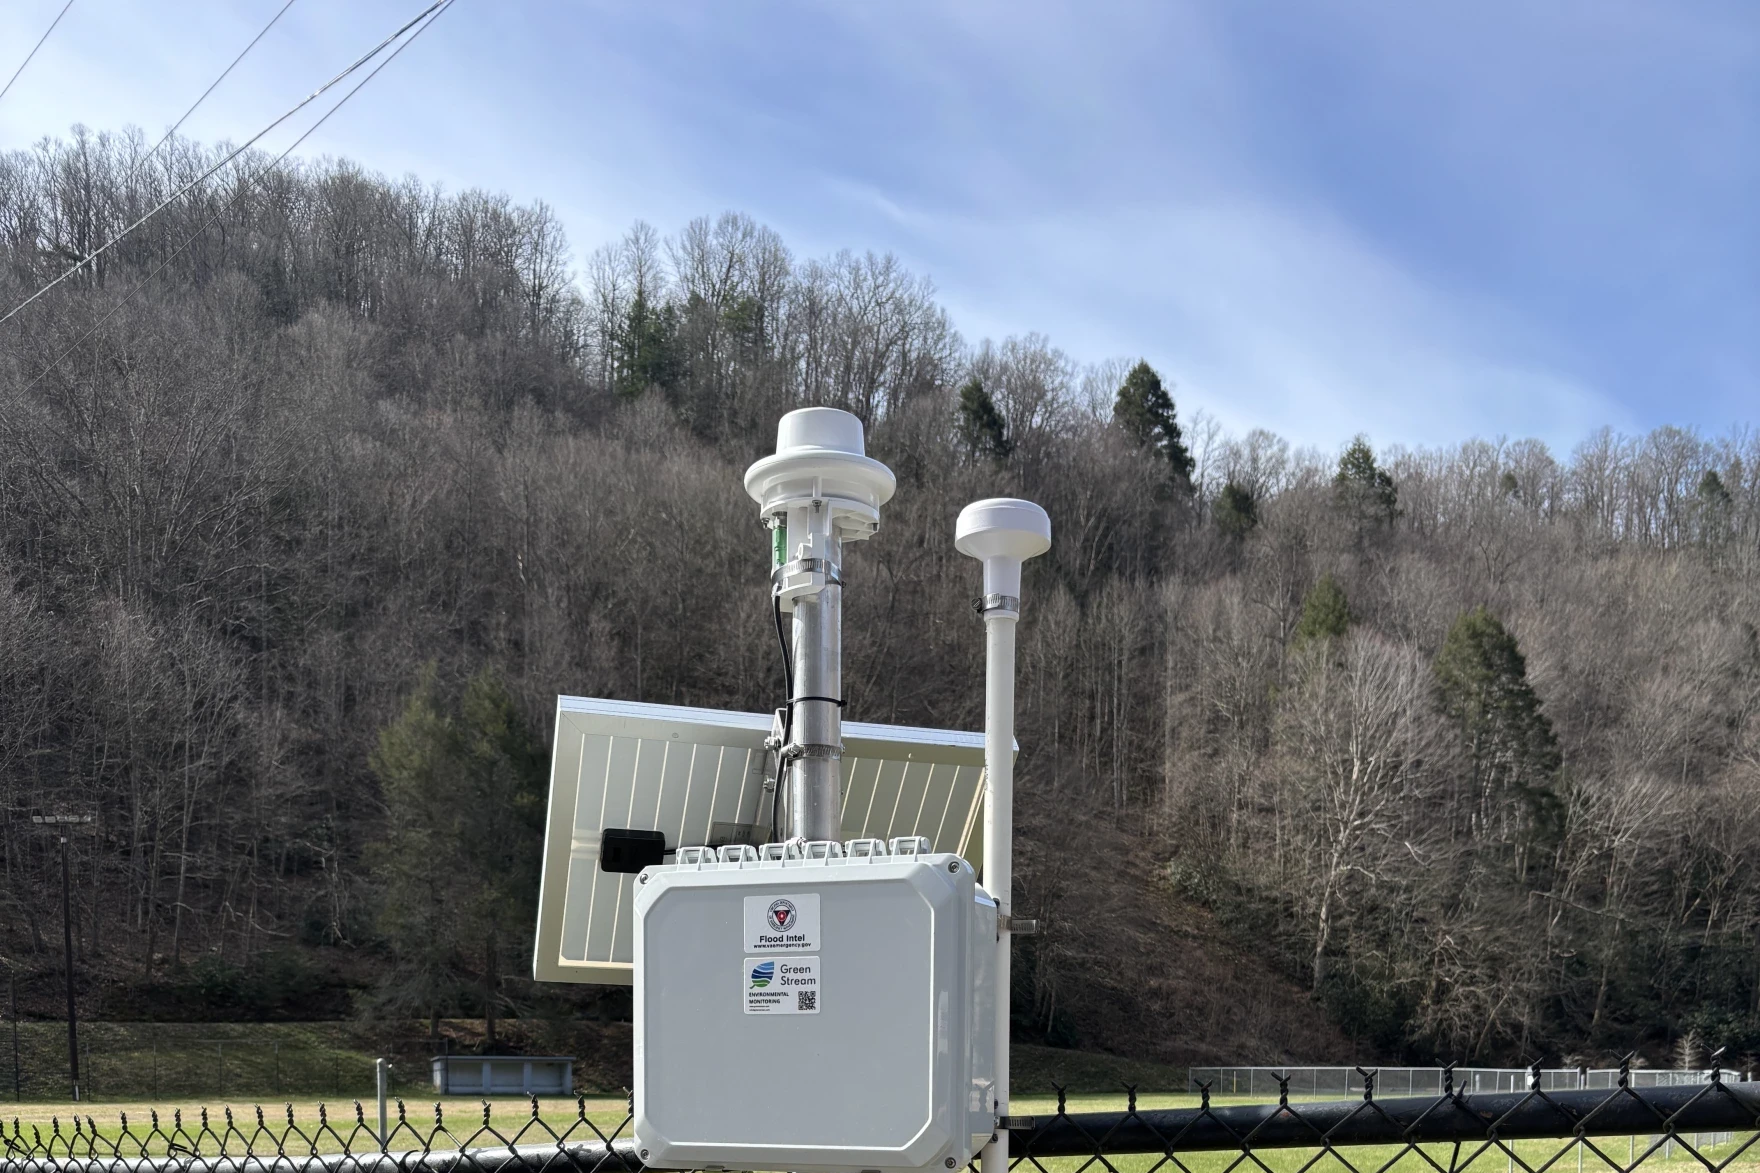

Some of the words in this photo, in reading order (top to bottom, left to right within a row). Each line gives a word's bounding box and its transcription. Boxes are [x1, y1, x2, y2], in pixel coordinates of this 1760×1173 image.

[759, 935, 784, 943] Flood
[786, 933, 805, 942] Intel
[780, 963, 811, 974] Green
[780, 975, 816, 986] Stream
